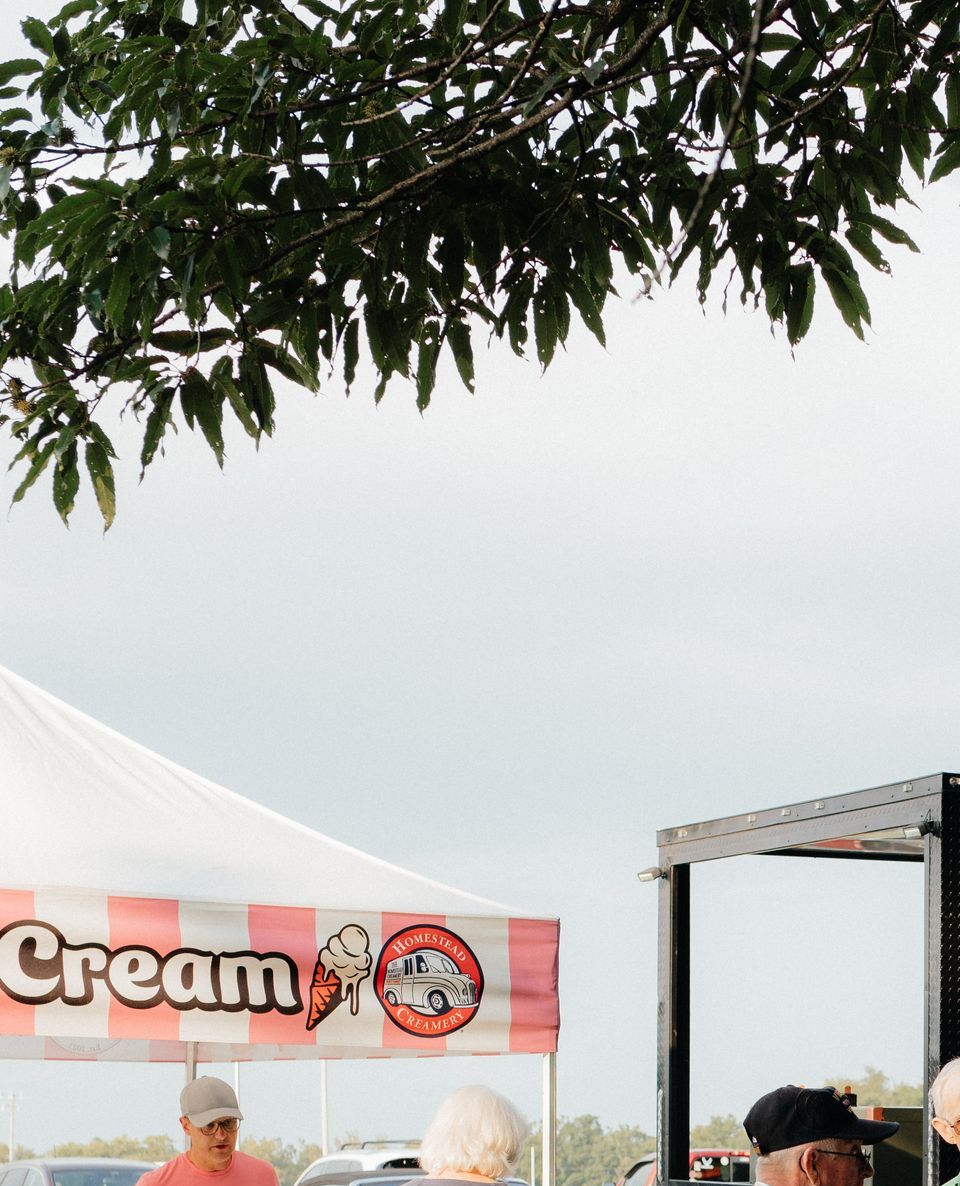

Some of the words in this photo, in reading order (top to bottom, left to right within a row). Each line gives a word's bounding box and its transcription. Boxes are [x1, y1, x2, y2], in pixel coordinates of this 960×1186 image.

[391, 933, 466, 962] HOMESTEAD
[0, 920, 303, 1014] Cream
[396, 1007, 465, 1030] CREAMERY
